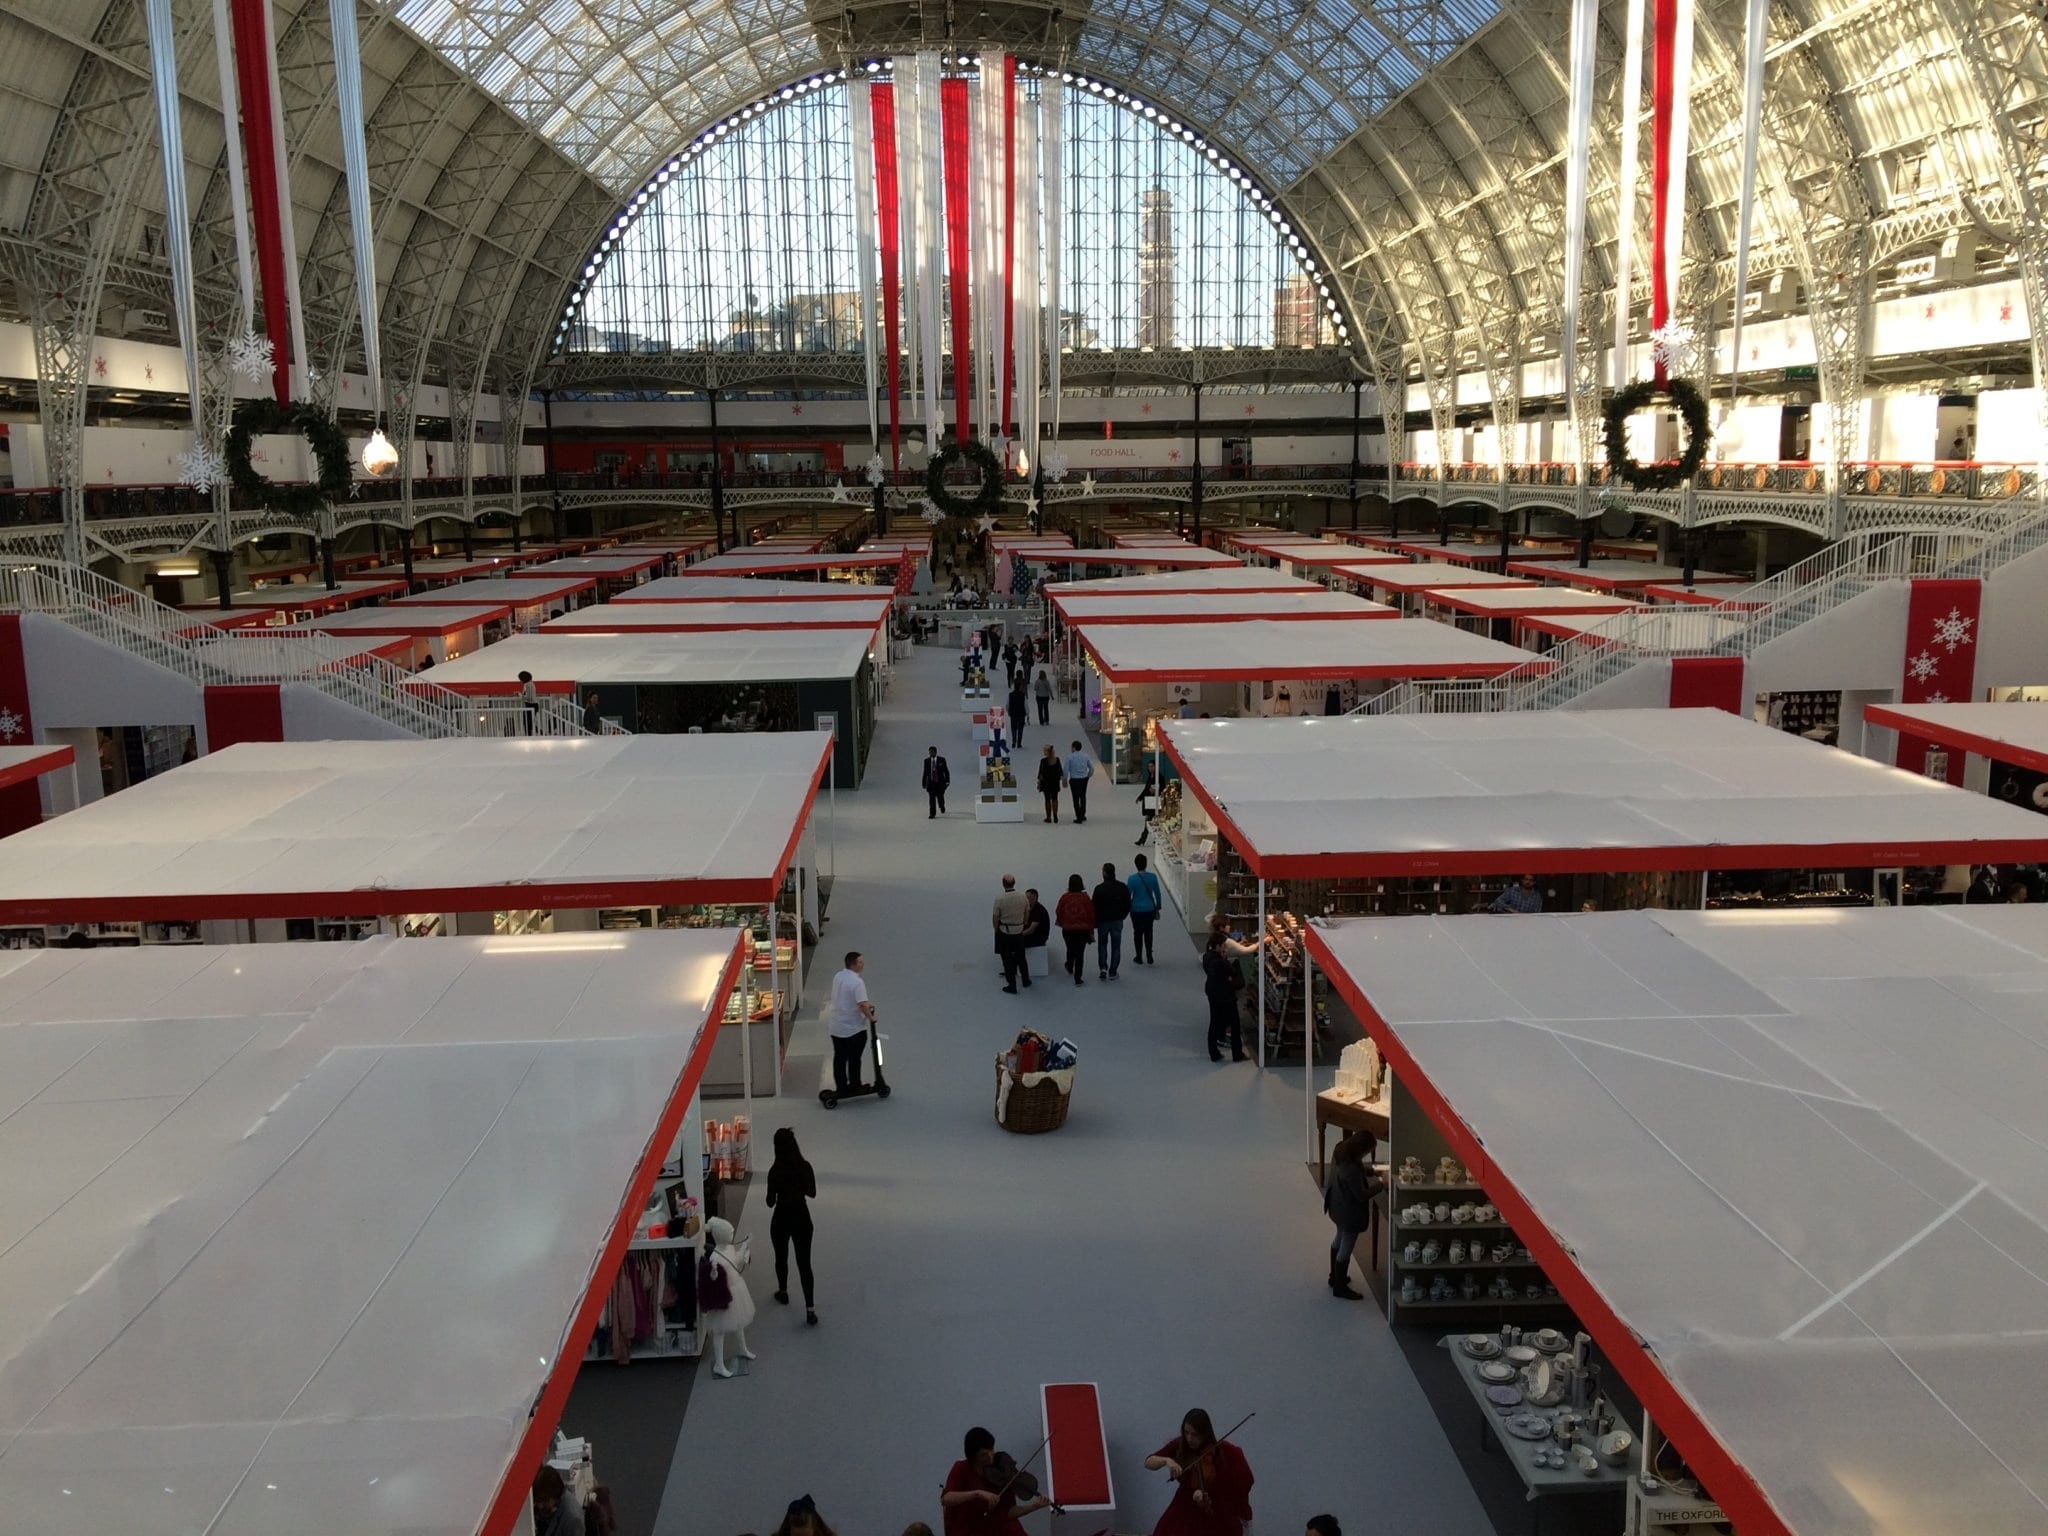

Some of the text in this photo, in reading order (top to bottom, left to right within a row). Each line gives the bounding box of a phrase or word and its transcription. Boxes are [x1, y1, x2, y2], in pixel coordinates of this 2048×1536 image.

[1090, 448, 1136, 457] FOOD HALL
[1656, 1511, 1679, 1521] THE
